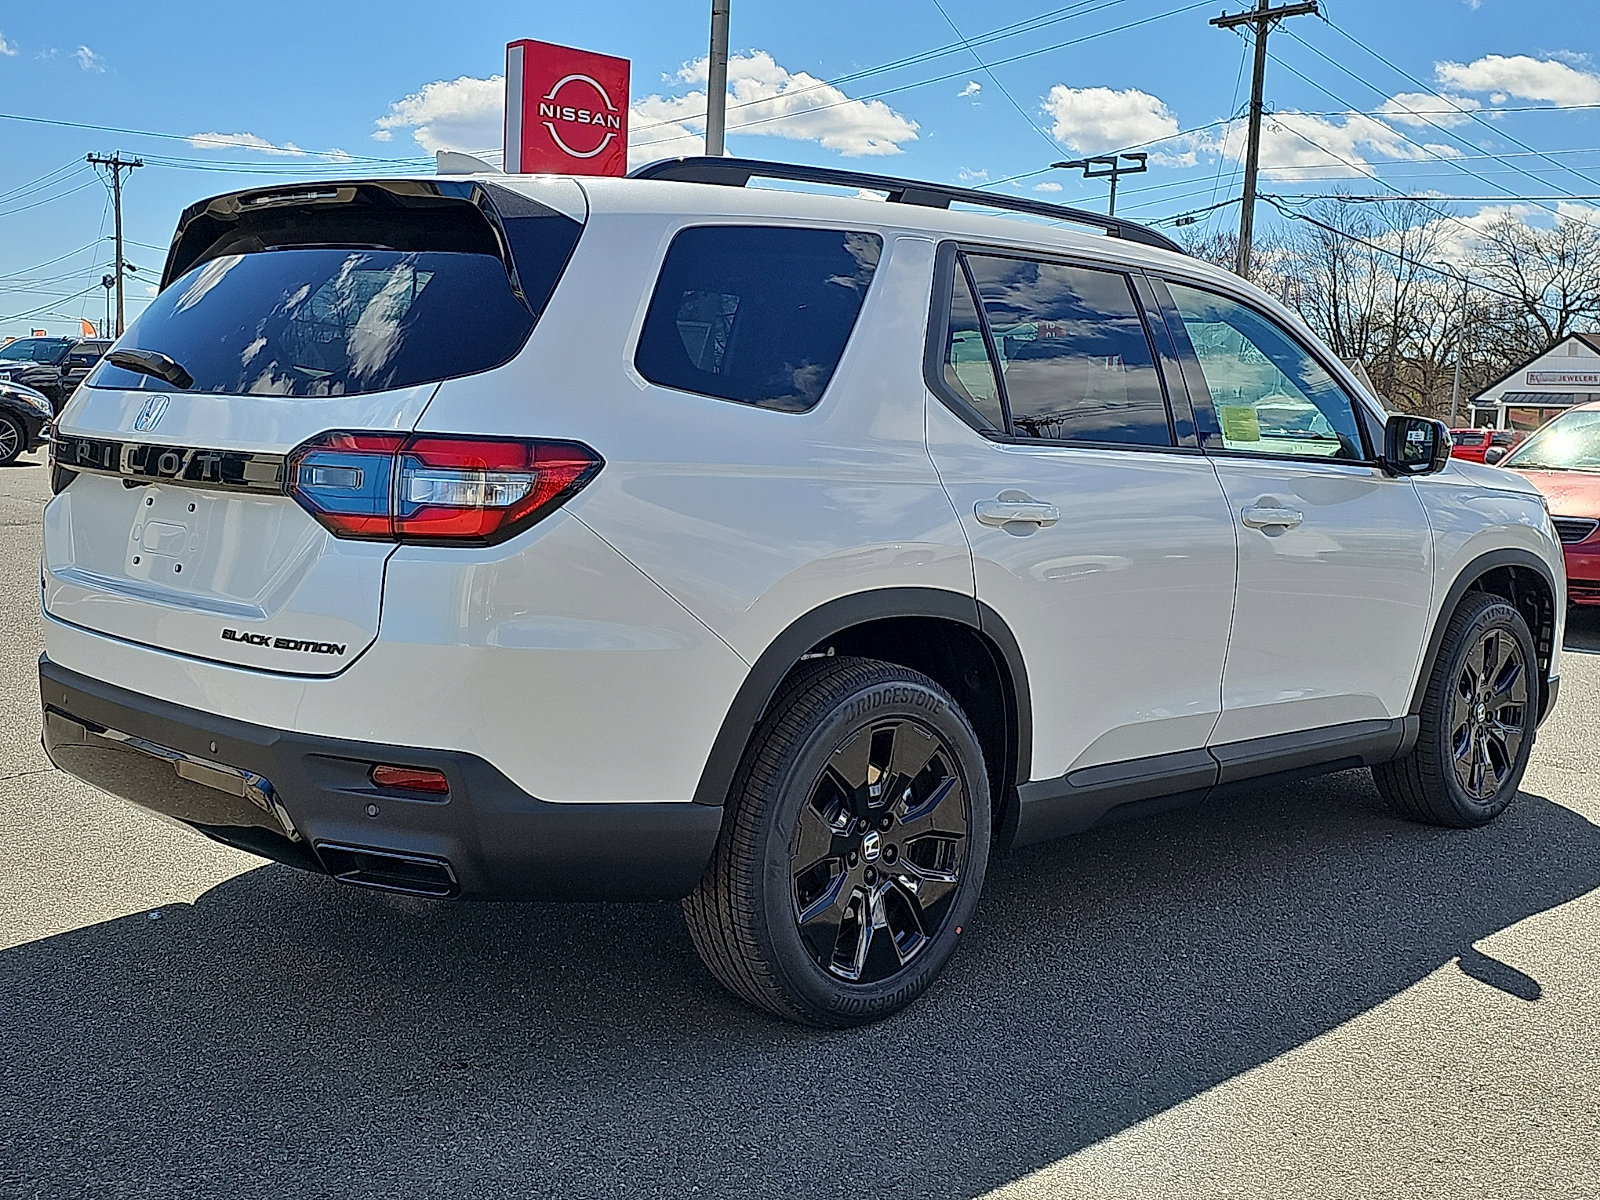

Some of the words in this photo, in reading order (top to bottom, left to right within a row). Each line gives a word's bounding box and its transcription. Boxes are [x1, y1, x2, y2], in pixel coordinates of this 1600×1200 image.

[539, 102, 620, 129] NISSAN
[76, 441, 220, 478] PILOT
[221, 628, 272, 647] BLACK
[273, 638, 347, 656] EDITION
[843, 687, 942, 724] BRIDGESTONE
